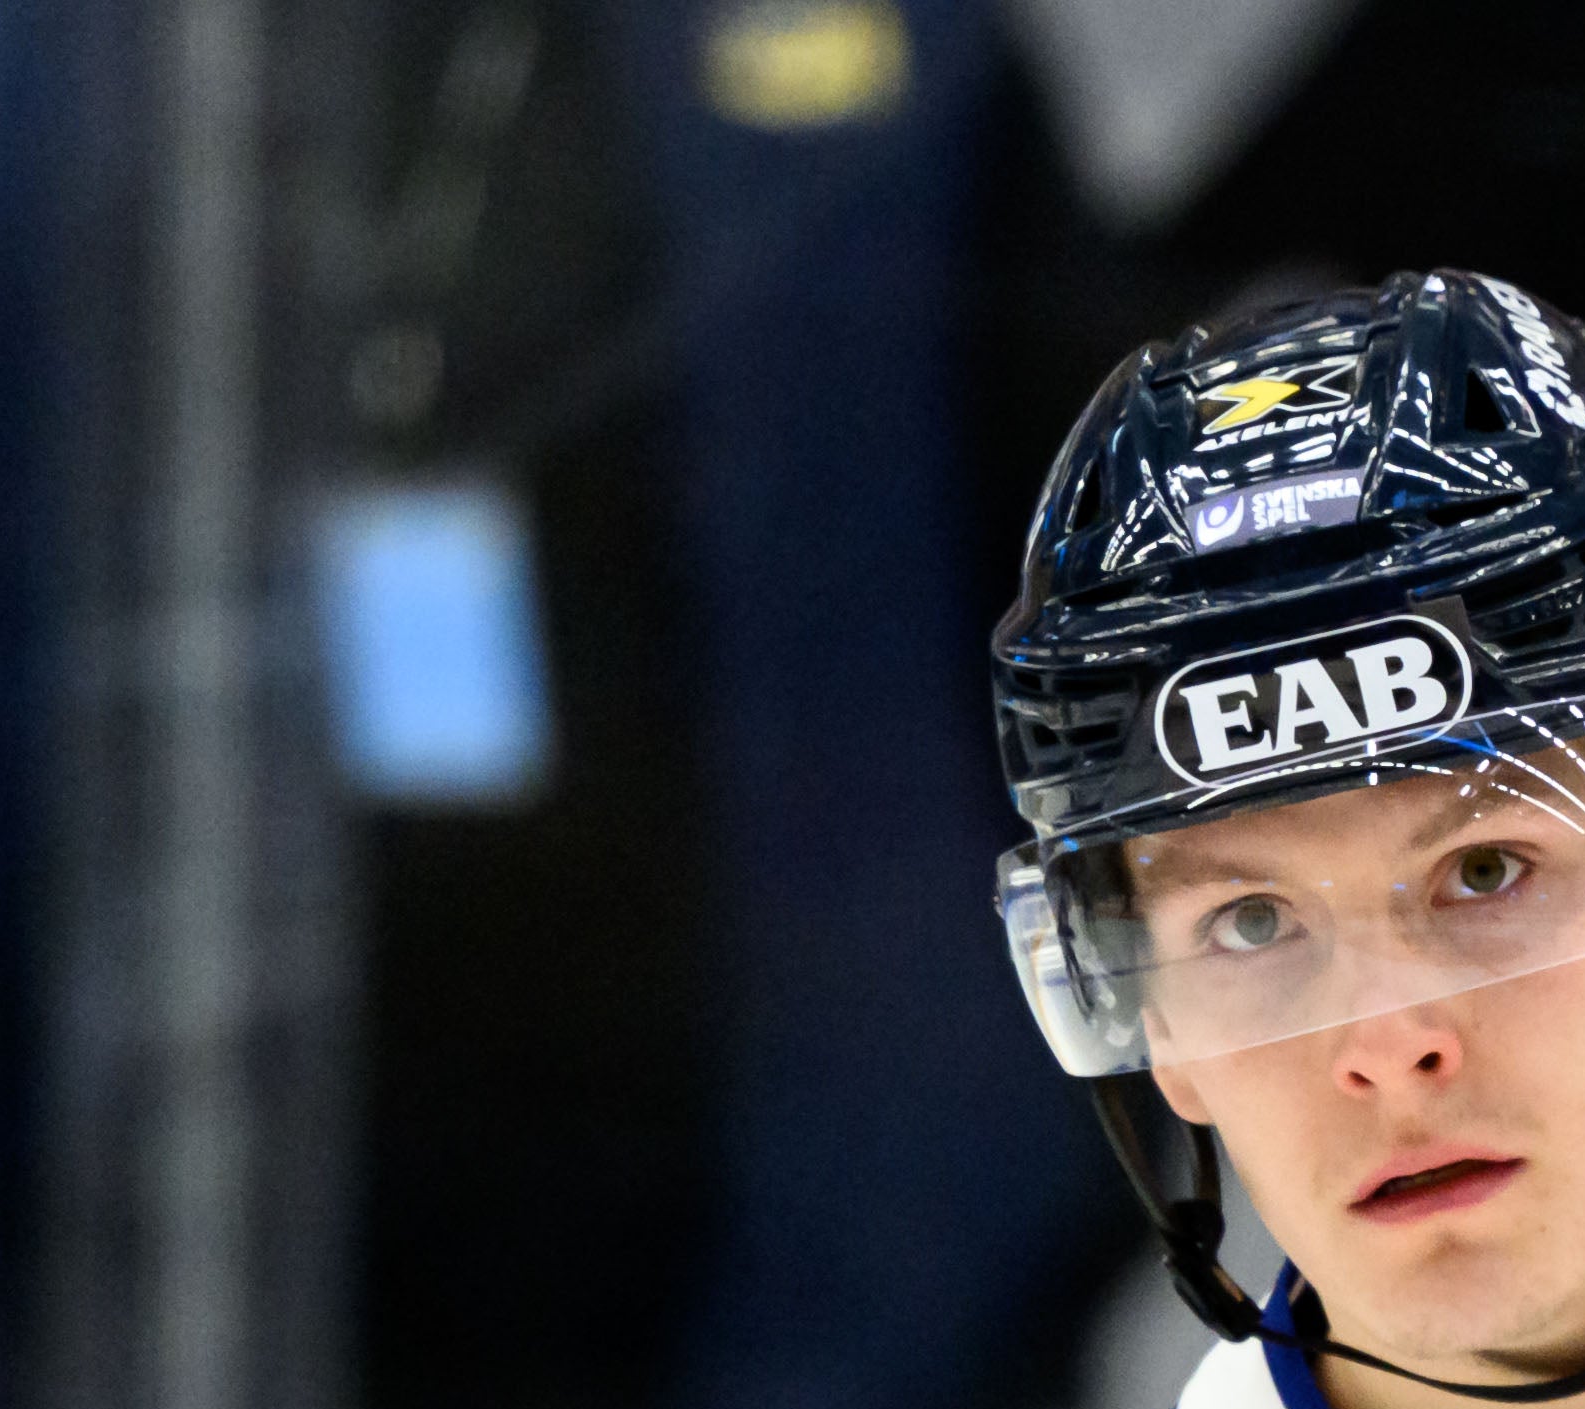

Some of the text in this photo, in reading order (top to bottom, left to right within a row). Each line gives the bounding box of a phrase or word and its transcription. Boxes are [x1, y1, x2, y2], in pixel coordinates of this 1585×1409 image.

[1193, 402, 1371, 452] AXELENT
[1251, 477, 1362, 508] SVENSKA
[1252, 499, 1312, 531] SPEL
[1179, 635, 1449, 772] EAB
